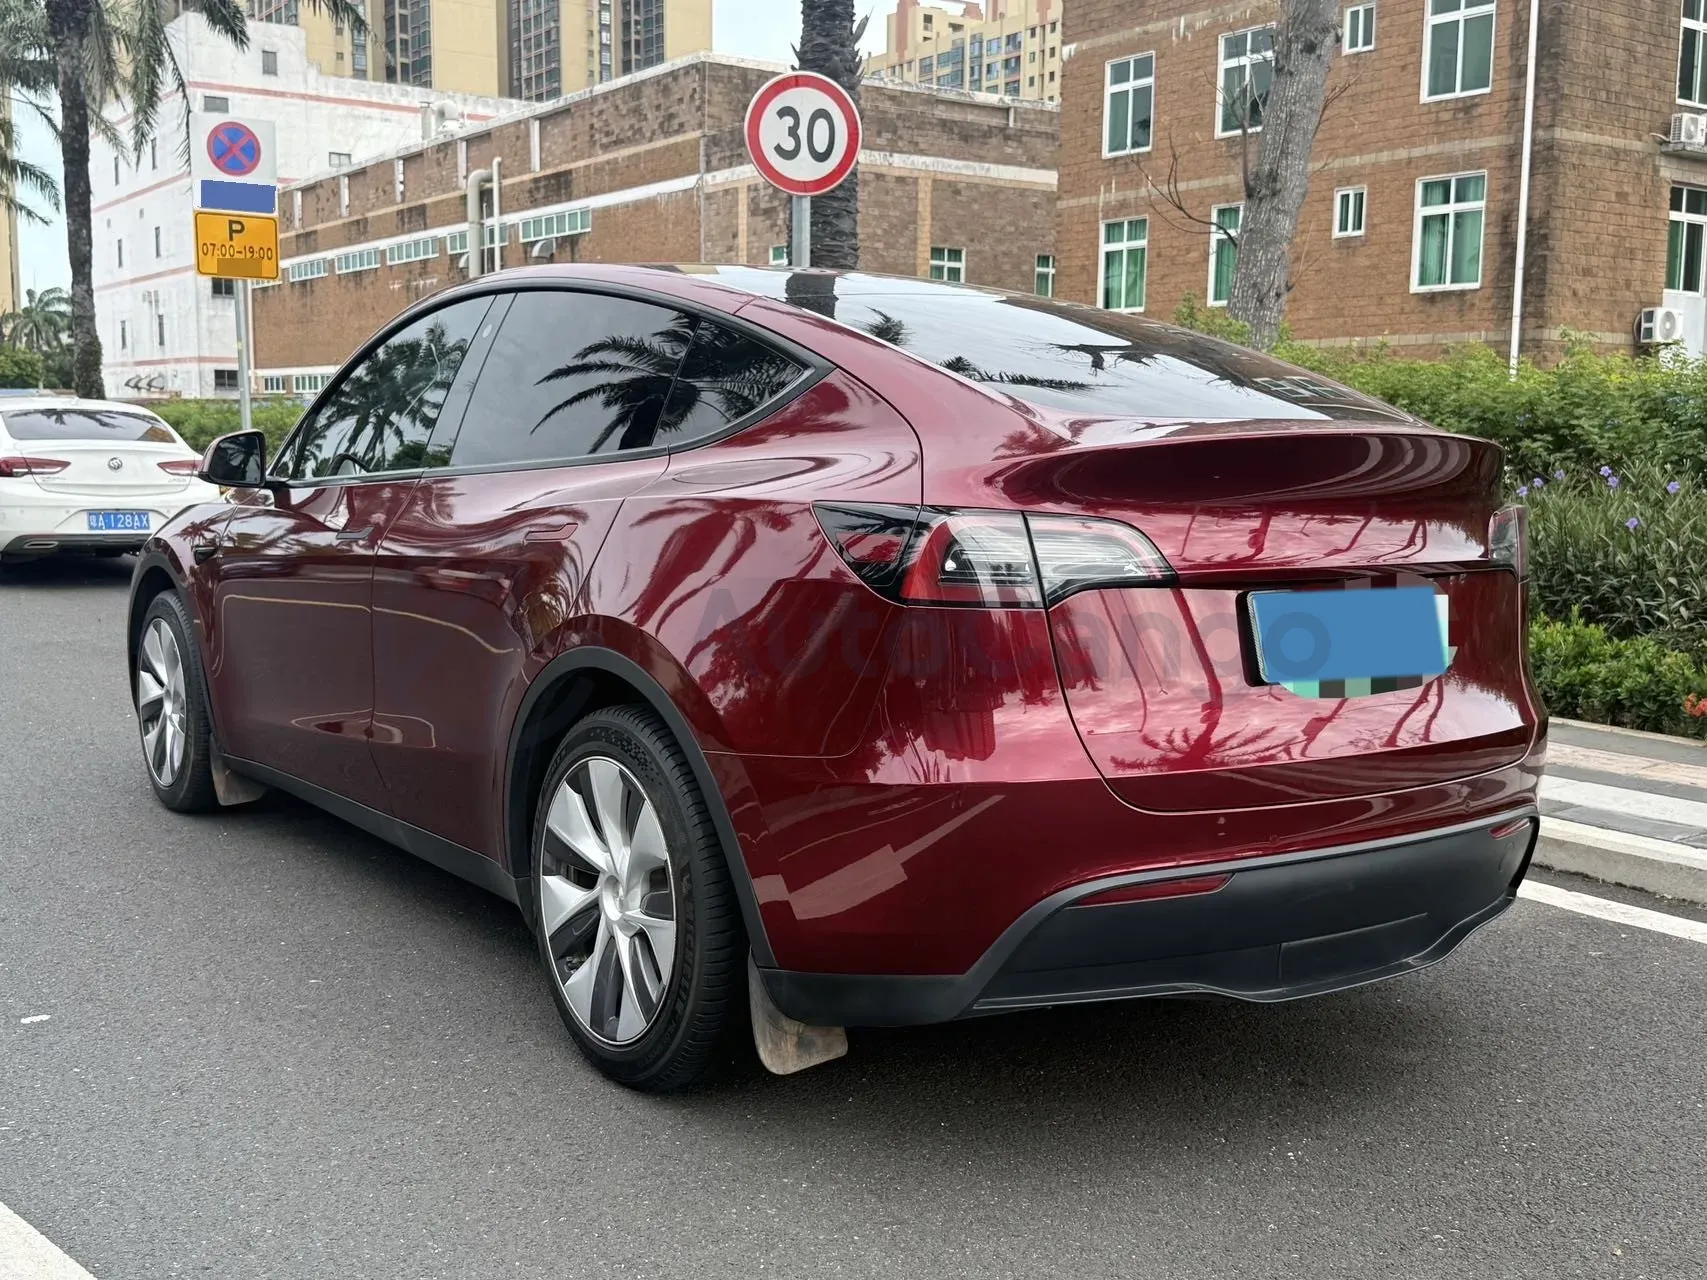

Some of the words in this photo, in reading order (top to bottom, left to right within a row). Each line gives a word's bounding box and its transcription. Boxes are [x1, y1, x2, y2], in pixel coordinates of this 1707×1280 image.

[773, 105, 836, 163] 30
[228, 219, 245, 241] P
[201, 242, 273, 261] 07:00-19:00
